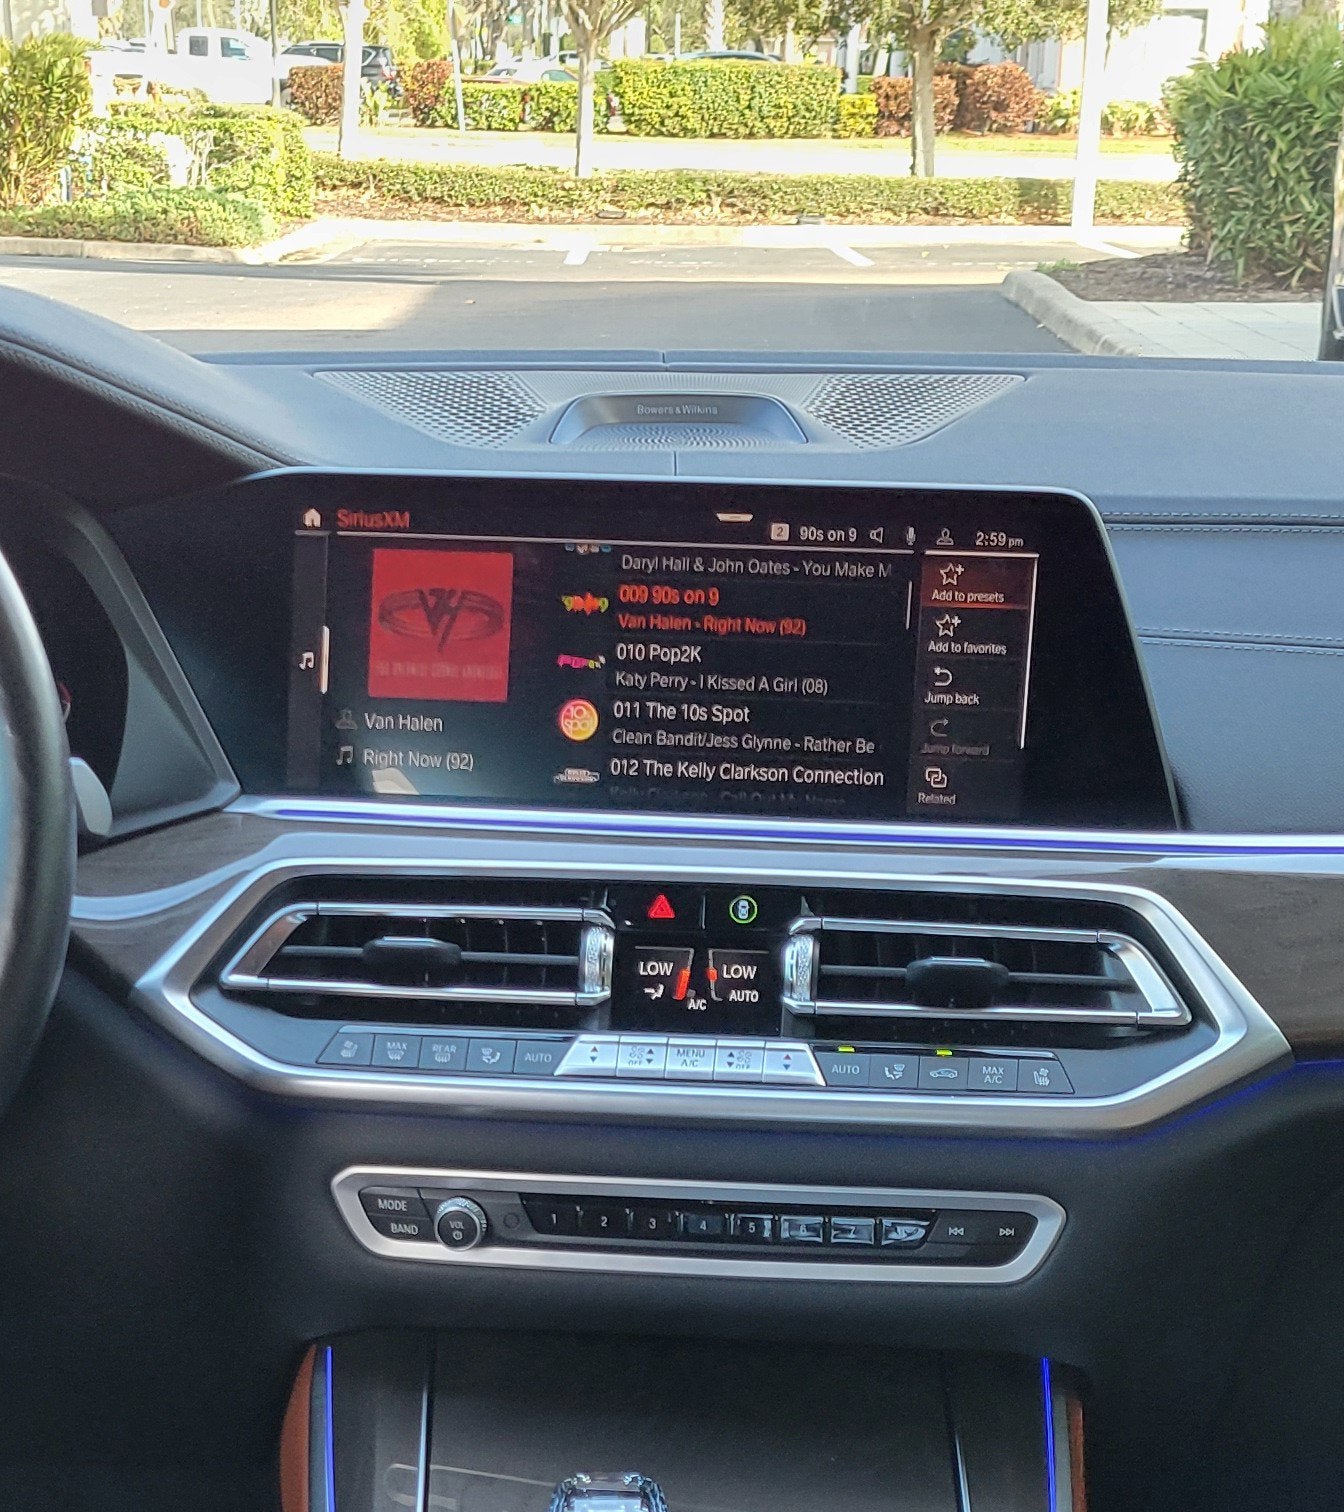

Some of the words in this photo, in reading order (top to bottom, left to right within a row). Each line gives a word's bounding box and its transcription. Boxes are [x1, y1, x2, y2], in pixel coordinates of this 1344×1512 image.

[337, 509, 410, 529] SiriusXM
[799, 527, 824, 542] 90s
[828, 529, 845, 542] on
[848, 528, 857, 542] 9
[975, 531, 1006, 547] 2:59
[1008, 537, 1024, 548] pm
[622, 554, 659, 573] Daryl
[662, 555, 690, 572] Hall
[693, 557, 705, 572] &
[708, 557, 744, 574] John
[748, 558, 791, 576] Oates
[802, 560, 831, 577] You
[835, 561, 875, 578] Make
[878, 563, 892, 578] M
[619, 585, 649, 603] 009
[652, 586, 680, 605] 90s
[684, 589, 705, 605] on
[708, 587, 720, 606] 9
[932, 589, 952, 601] Add
[955, 590, 965, 602] to
[967, 591, 1005, 604] presets
[618, 614, 646, 629] Van
[650, 615, 691, 631] Halen
[704, 616, 741, 635] Right
[745, 617, 776, 634] Now
[780, 617, 806, 636] (92)
[617, 642, 646, 661] 010
[650, 643, 702, 664] Pop2K
[928, 641, 949, 653] Add
[951, 641, 961, 653] to
[963, 641, 1007, 656] favorites
[615, 671, 647, 689] Katy
[650, 672, 688, 691] Perry
[707, 675, 756, 693] Kissed
[758, 677, 770, 693] A
[773, 677, 798, 694] Girl
[802, 677, 828, 696] (08)
[924, 691, 953, 706] Jump
[955, 691, 980, 705] back
[613, 701, 640, 719] 011
[646, 702, 676, 720] The
[681, 703, 707, 721] 10s
[711, 704, 750, 725] Spot
[364, 712, 394, 730] Van
[399, 713, 444, 732] Halen
[612, 729, 652, 746] Clean
[656, 730, 739, 749] Bandit/Jess
[742, 733, 792, 753] Glynne
[804, 736, 852, 753] Rather
[855, 738, 875, 754] Be
[363, 748, 404, 769] Right
[409, 750, 442, 769] Now
[446, 751, 474, 772] (92)
[610, 758, 639, 776] 012
[643, 759, 673, 778] The
[677, 761, 716, 782] Kelly
[720, 763, 789, 783] Clarkson
[793, 765, 884, 786] Connection
[918, 792, 957, 805] Related
[639, 961, 674, 976] LOW
[723, 964, 758, 980] LOW
[729, 989, 759, 1003] AUTO
[687, 999, 707, 1011] A/C
[387, 1042, 408, 1051] MAX
[676, 1048, 706, 1059] MENU
[524, 1052, 552, 1063] AUTO
[681, 1058, 699, 1068] A/C
[831, 1064, 860, 1076] AUTO
[982, 1066, 1005, 1076] MAX
[984, 1074, 1003, 1085] A/C
[378, 1198, 408, 1212] MODE
[391, 1222, 419, 1236] BAND
[448, 1220, 465, 1230] VOL
[600, 1216, 608, 1228] 2
[649, 1218, 657, 1230] 3
[699, 1220, 707, 1231] 4
[748, 1222, 756, 1233] 5
